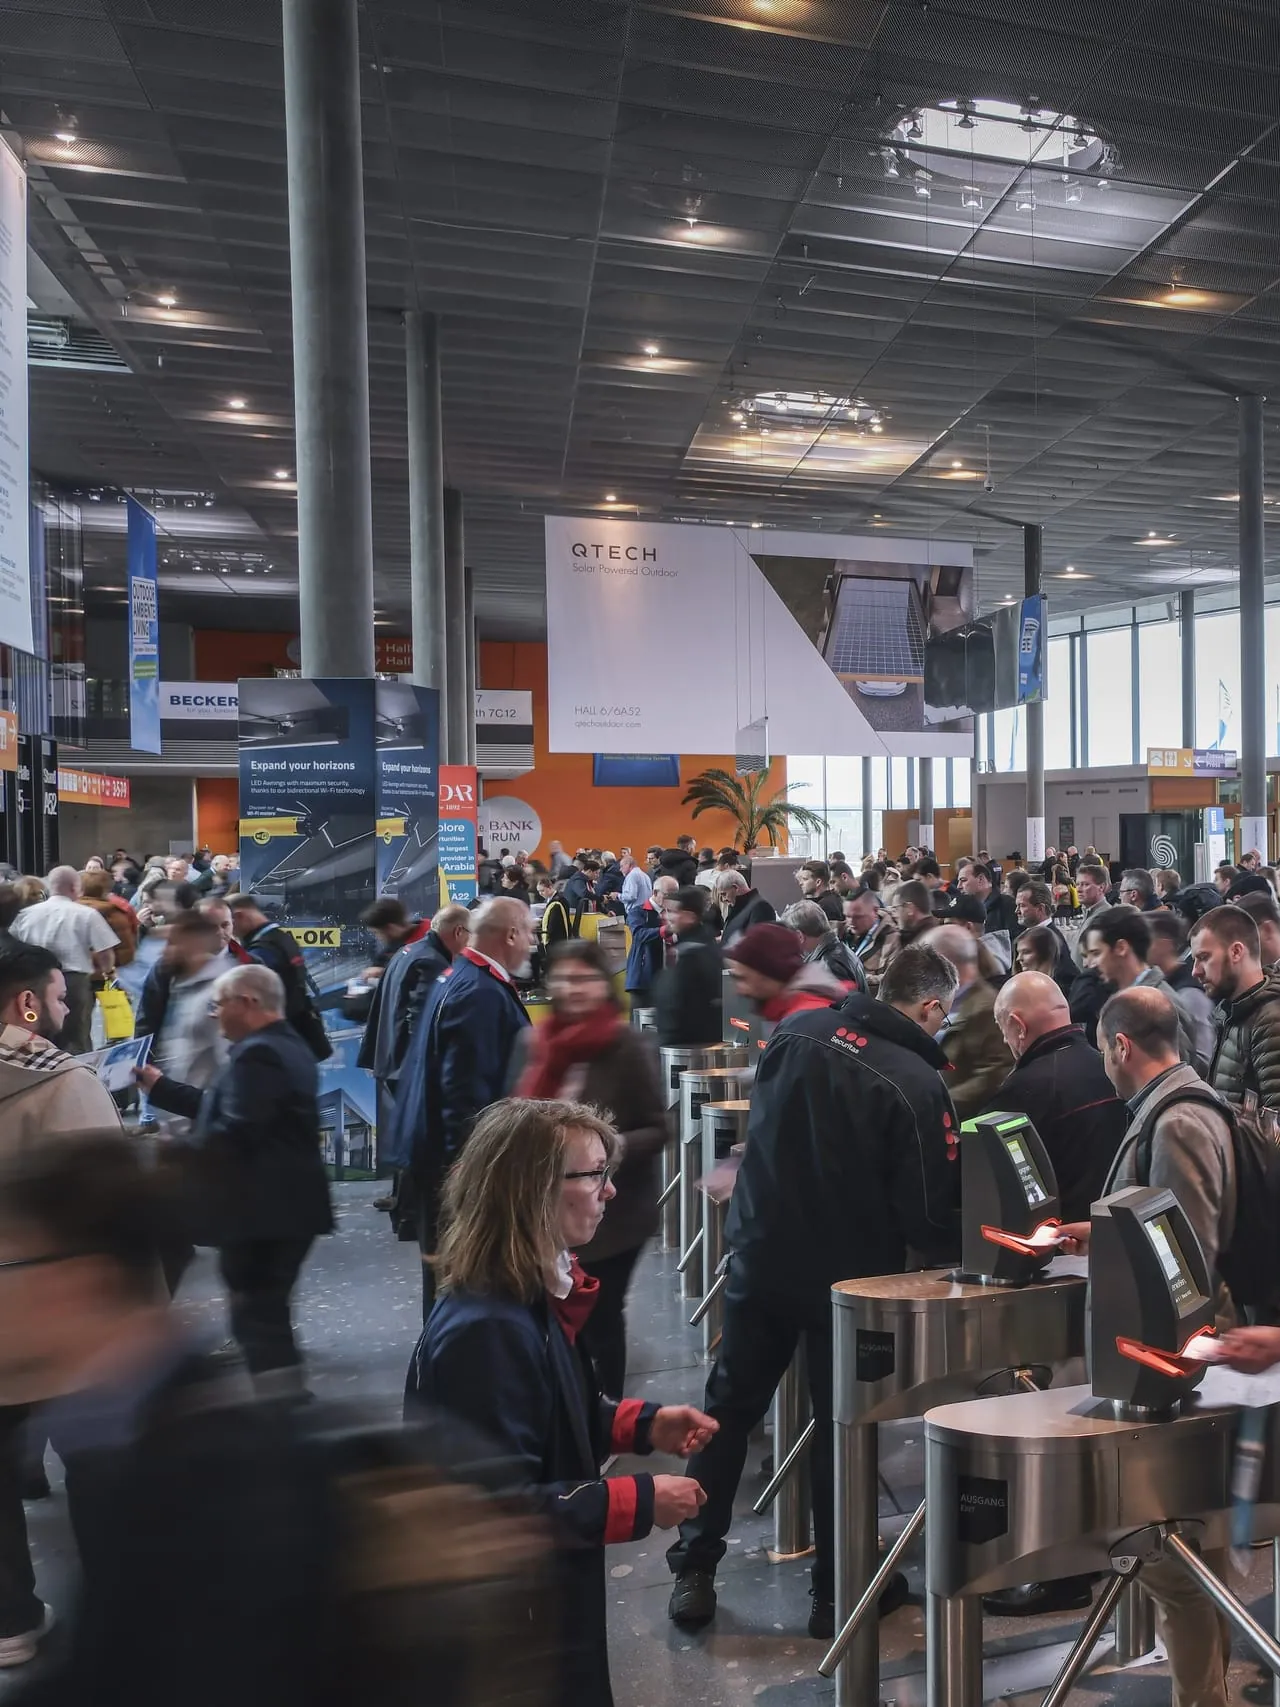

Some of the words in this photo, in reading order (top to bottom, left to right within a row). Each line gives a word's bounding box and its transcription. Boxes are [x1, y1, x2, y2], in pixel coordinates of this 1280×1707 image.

[571, 542, 657, 562] QTECH
[572, 562, 596, 573] Solar
[599, 564, 639, 575] Powered
[641, 566, 679, 577] Outdoor
[169, 695, 239, 707] BECKER
[488, 708, 517, 718] 7C12
[574, 705, 597, 716] HALL
[599, 706, 641, 717] 6/6A52
[250, 760, 287, 772] Expand
[288, 762, 311, 772] your
[313, 760, 355, 770] horizons
[382, 761, 400, 773] Expand
[400, 763, 411, 774] your
[411, 763, 431, 774] horizons
[263, 780, 286, 788] Awnings
[439, 784, 473, 801] DAR
[489, 820, 534, 831] BANK
[491, 832, 520, 842] RUM
[440, 854, 465, 862] provider
[443, 863, 475, 871] Arabia
[451, 892, 470, 901] A22
[830, 1035, 860, 1054] Securitas
[960, 1493, 1005, 1508] AUSGANG
